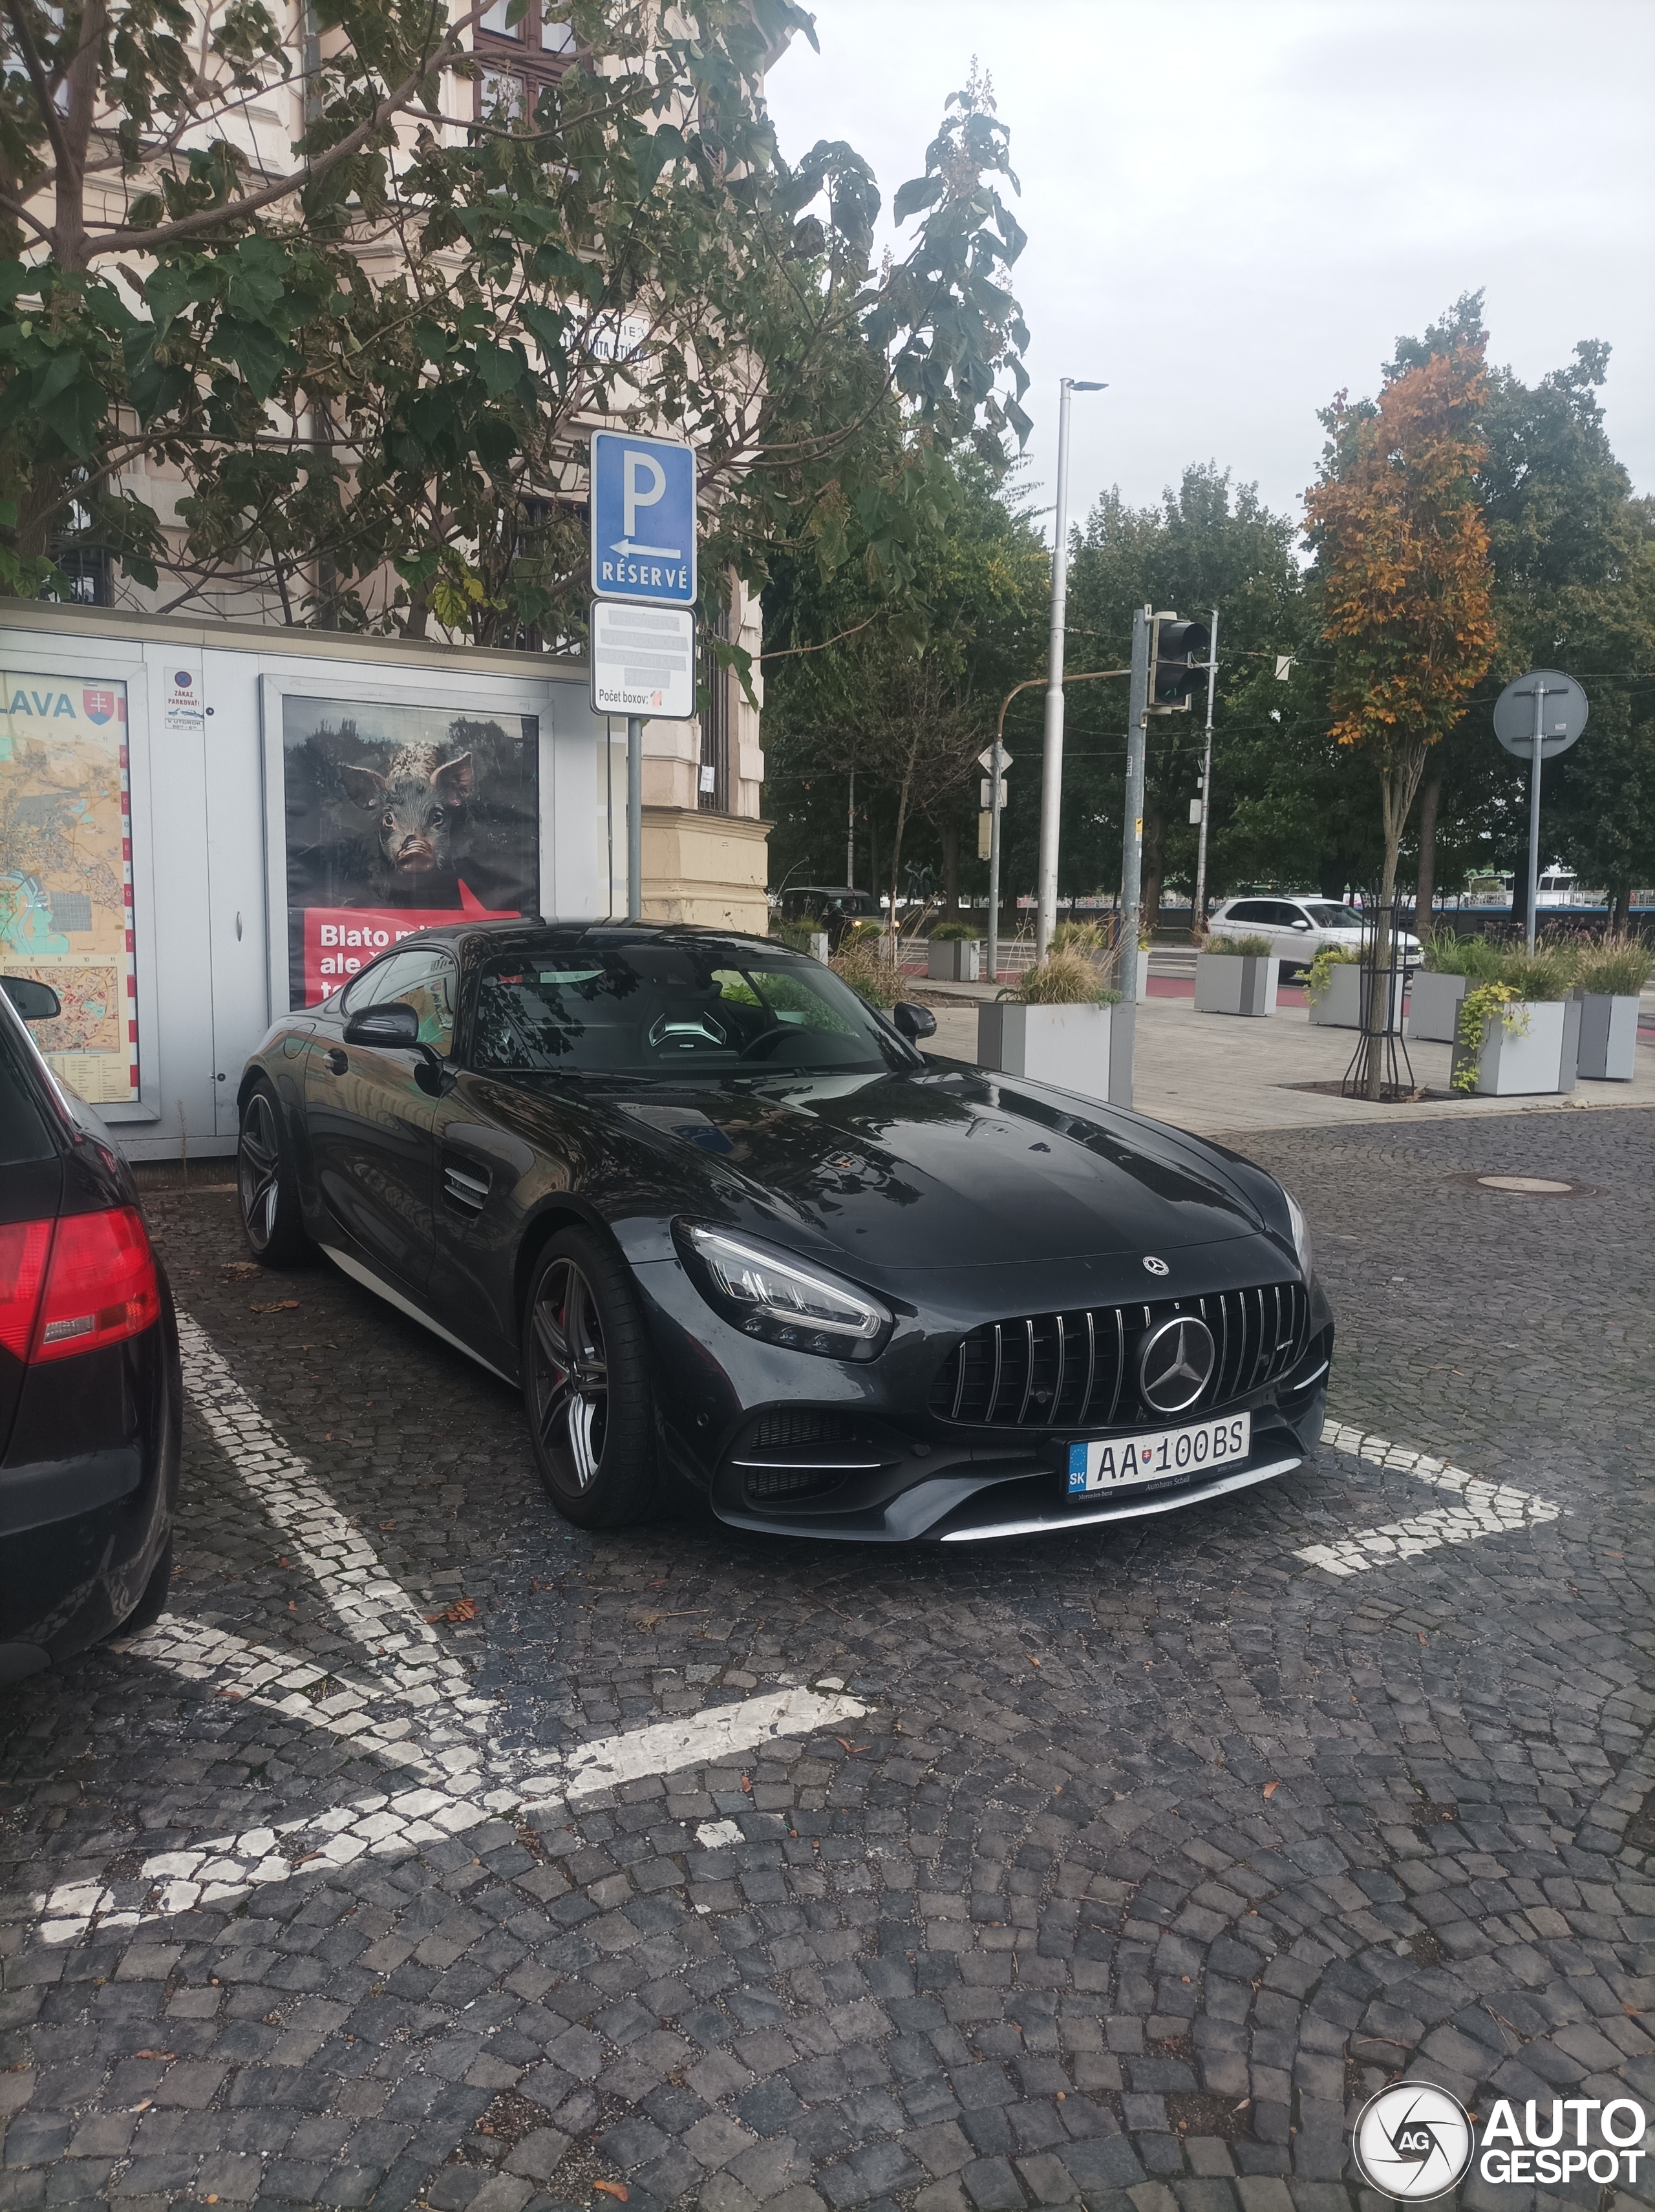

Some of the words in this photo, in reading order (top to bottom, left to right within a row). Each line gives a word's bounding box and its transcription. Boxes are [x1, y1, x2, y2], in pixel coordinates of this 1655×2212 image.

[623, 450, 666, 537] P
[603, 559, 687, 590] RÉSERVÉ
[175, 689, 193, 697] ZÁKAZ
[599, 688, 621, 702] Počet
[623, 691, 648, 705] boxov:
[321, 924, 389, 947] Blato
[320, 953, 361, 974] ale
[1097, 1443, 1138, 1482] AA
[1154, 1421, 1243, 1473] 100BS
[1069, 1472, 1085, 1485] SK
[1145, 1481, 1173, 1491] Autohaus
[1173, 1474, 1191, 1485] Schall
[1078, 1491, 1113, 1500] Mercedes-Benz
